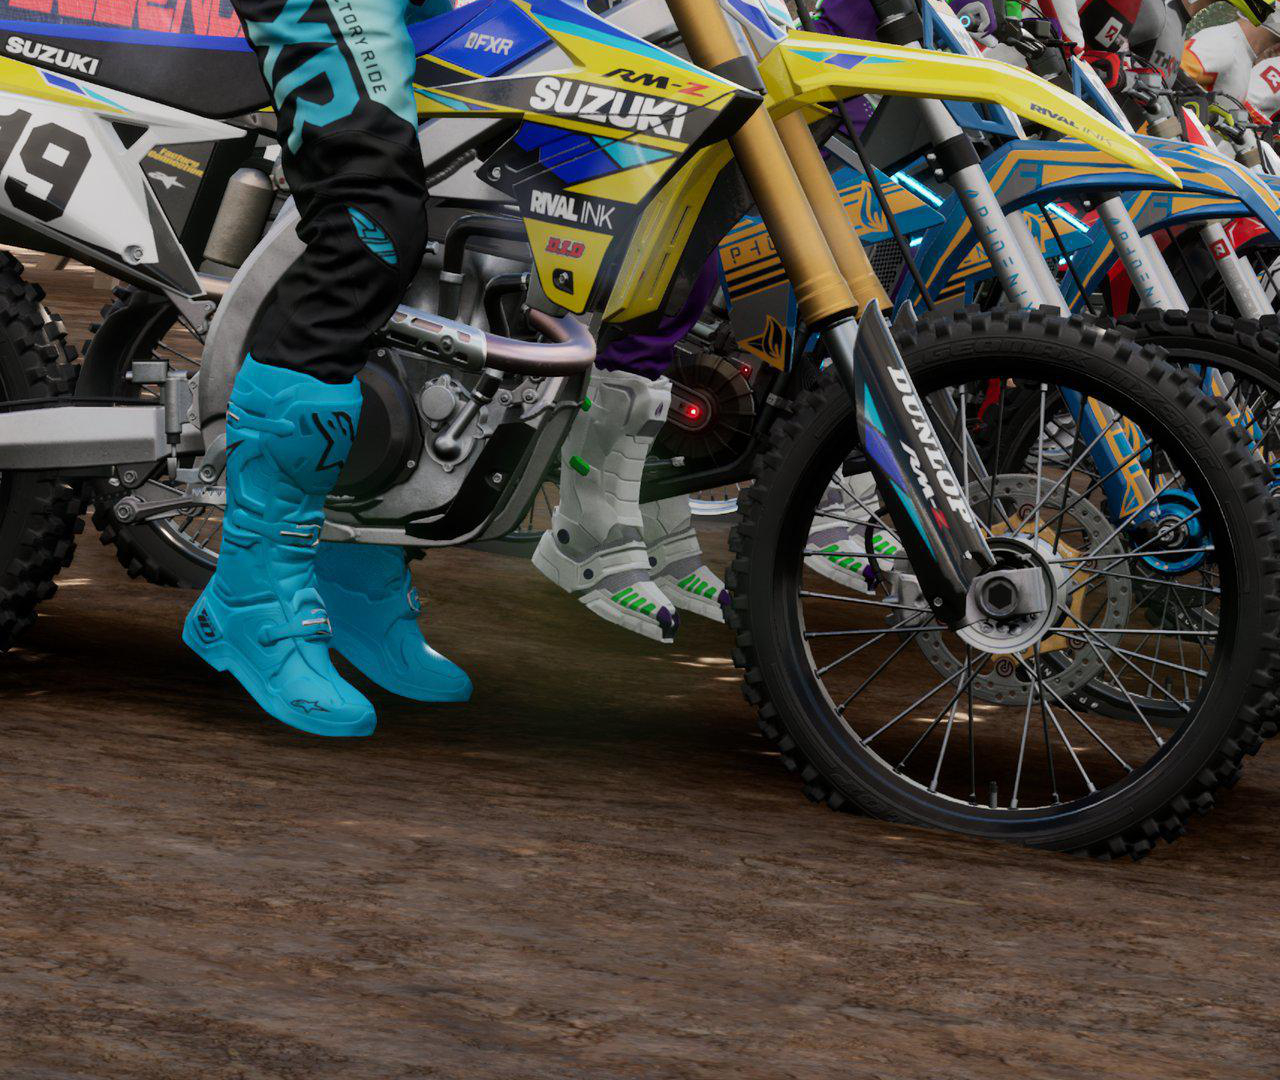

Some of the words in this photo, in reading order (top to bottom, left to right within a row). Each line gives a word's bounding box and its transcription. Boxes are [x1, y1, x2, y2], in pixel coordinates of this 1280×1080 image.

[5, 35, 100, 76] SUZUKI
[476, 33, 515, 57] FXR
[360, 49, 388, 96] RIDE
[602, 68, 710, 98] RM-Z
[529, 76, 689, 140] SUZUKI
[1030, 102, 1080, 130] RIVAL
[1082, 126, 1113, 147] INK
[530, 189, 579, 223] RIVAL
[580, 200, 616, 231] INK
[886, 366, 977, 529] DUNLOP
